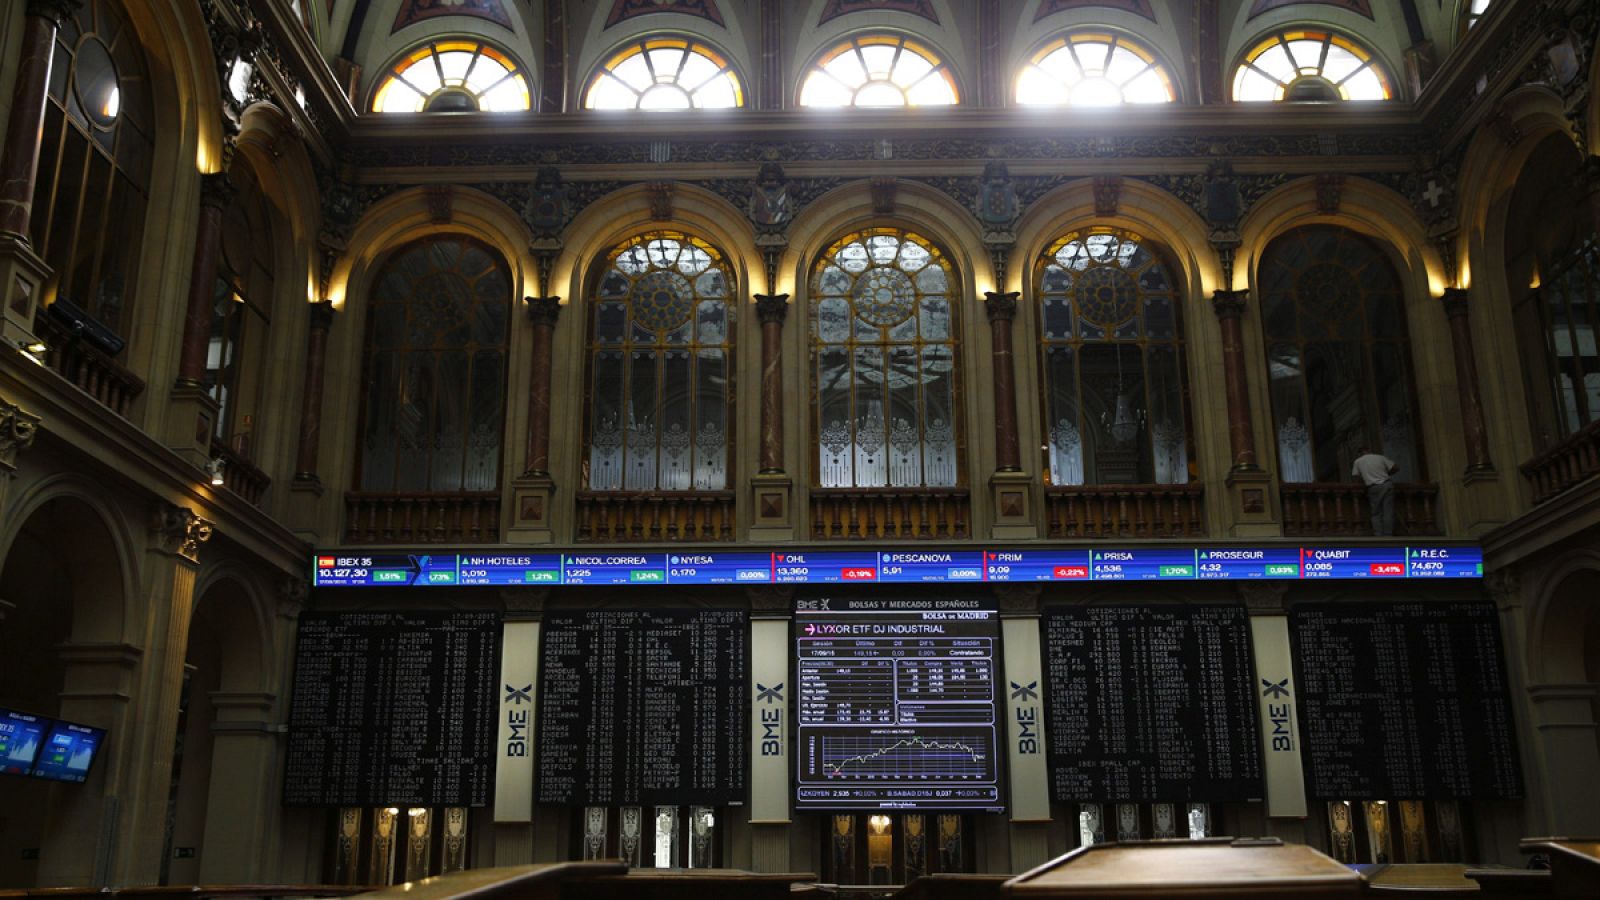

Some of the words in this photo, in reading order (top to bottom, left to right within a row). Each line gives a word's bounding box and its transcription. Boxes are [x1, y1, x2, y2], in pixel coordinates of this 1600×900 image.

[998, 553, 1022, 562] PRIM
[1103, 552, 1134, 561] PRISA
[1209, 551, 1264, 560] PROSEGUR
[1315, 550, 1351, 559] QUABIT
[1420, 549, 1449, 558] R.E.C.
[337, 558, 359, 567] IBEX
[361, 558, 372, 567] 35
[471, 557, 485, 566] NH
[487, 557, 532, 567] HOTELES
[575, 556, 647, 566] NICOL.CORREA
[681, 555, 714, 565] NYESA
[786, 555, 807, 564] OHL
[892, 554, 952, 563] PESCANOVA
[319, 569, 368, 578] 10.127,30
[461, 570, 487, 578] 5,010
[566, 569, 592, 577] 1,225
[740, 571, 765, 579] 0,00%
[952, 569, 977, 578] 0,00%
[1164, 567, 1188, 575] 1,70%
[636, 572, 659, 580] 1,24%
[849, 601, 879, 609] BOLSAS
[881, 601, 886, 609] Y
[889, 601, 934, 609] MERCADOS
[935, 599, 980, 609] ESPAÑOLES
[922, 612, 946, 620] BOLSA
[956, 612, 989, 620] MADRID
[816, 624, 850, 634] LYXOR
[852, 624, 871, 633] ETF
[873, 624, 885, 633] DJ
[887, 624, 945, 633] INDUSTRIAL
[761, 708, 779, 755] BME
[1016, 707, 1037, 753] BME
[1269, 704, 1292, 751] BME
[508, 710, 526, 756] BME
